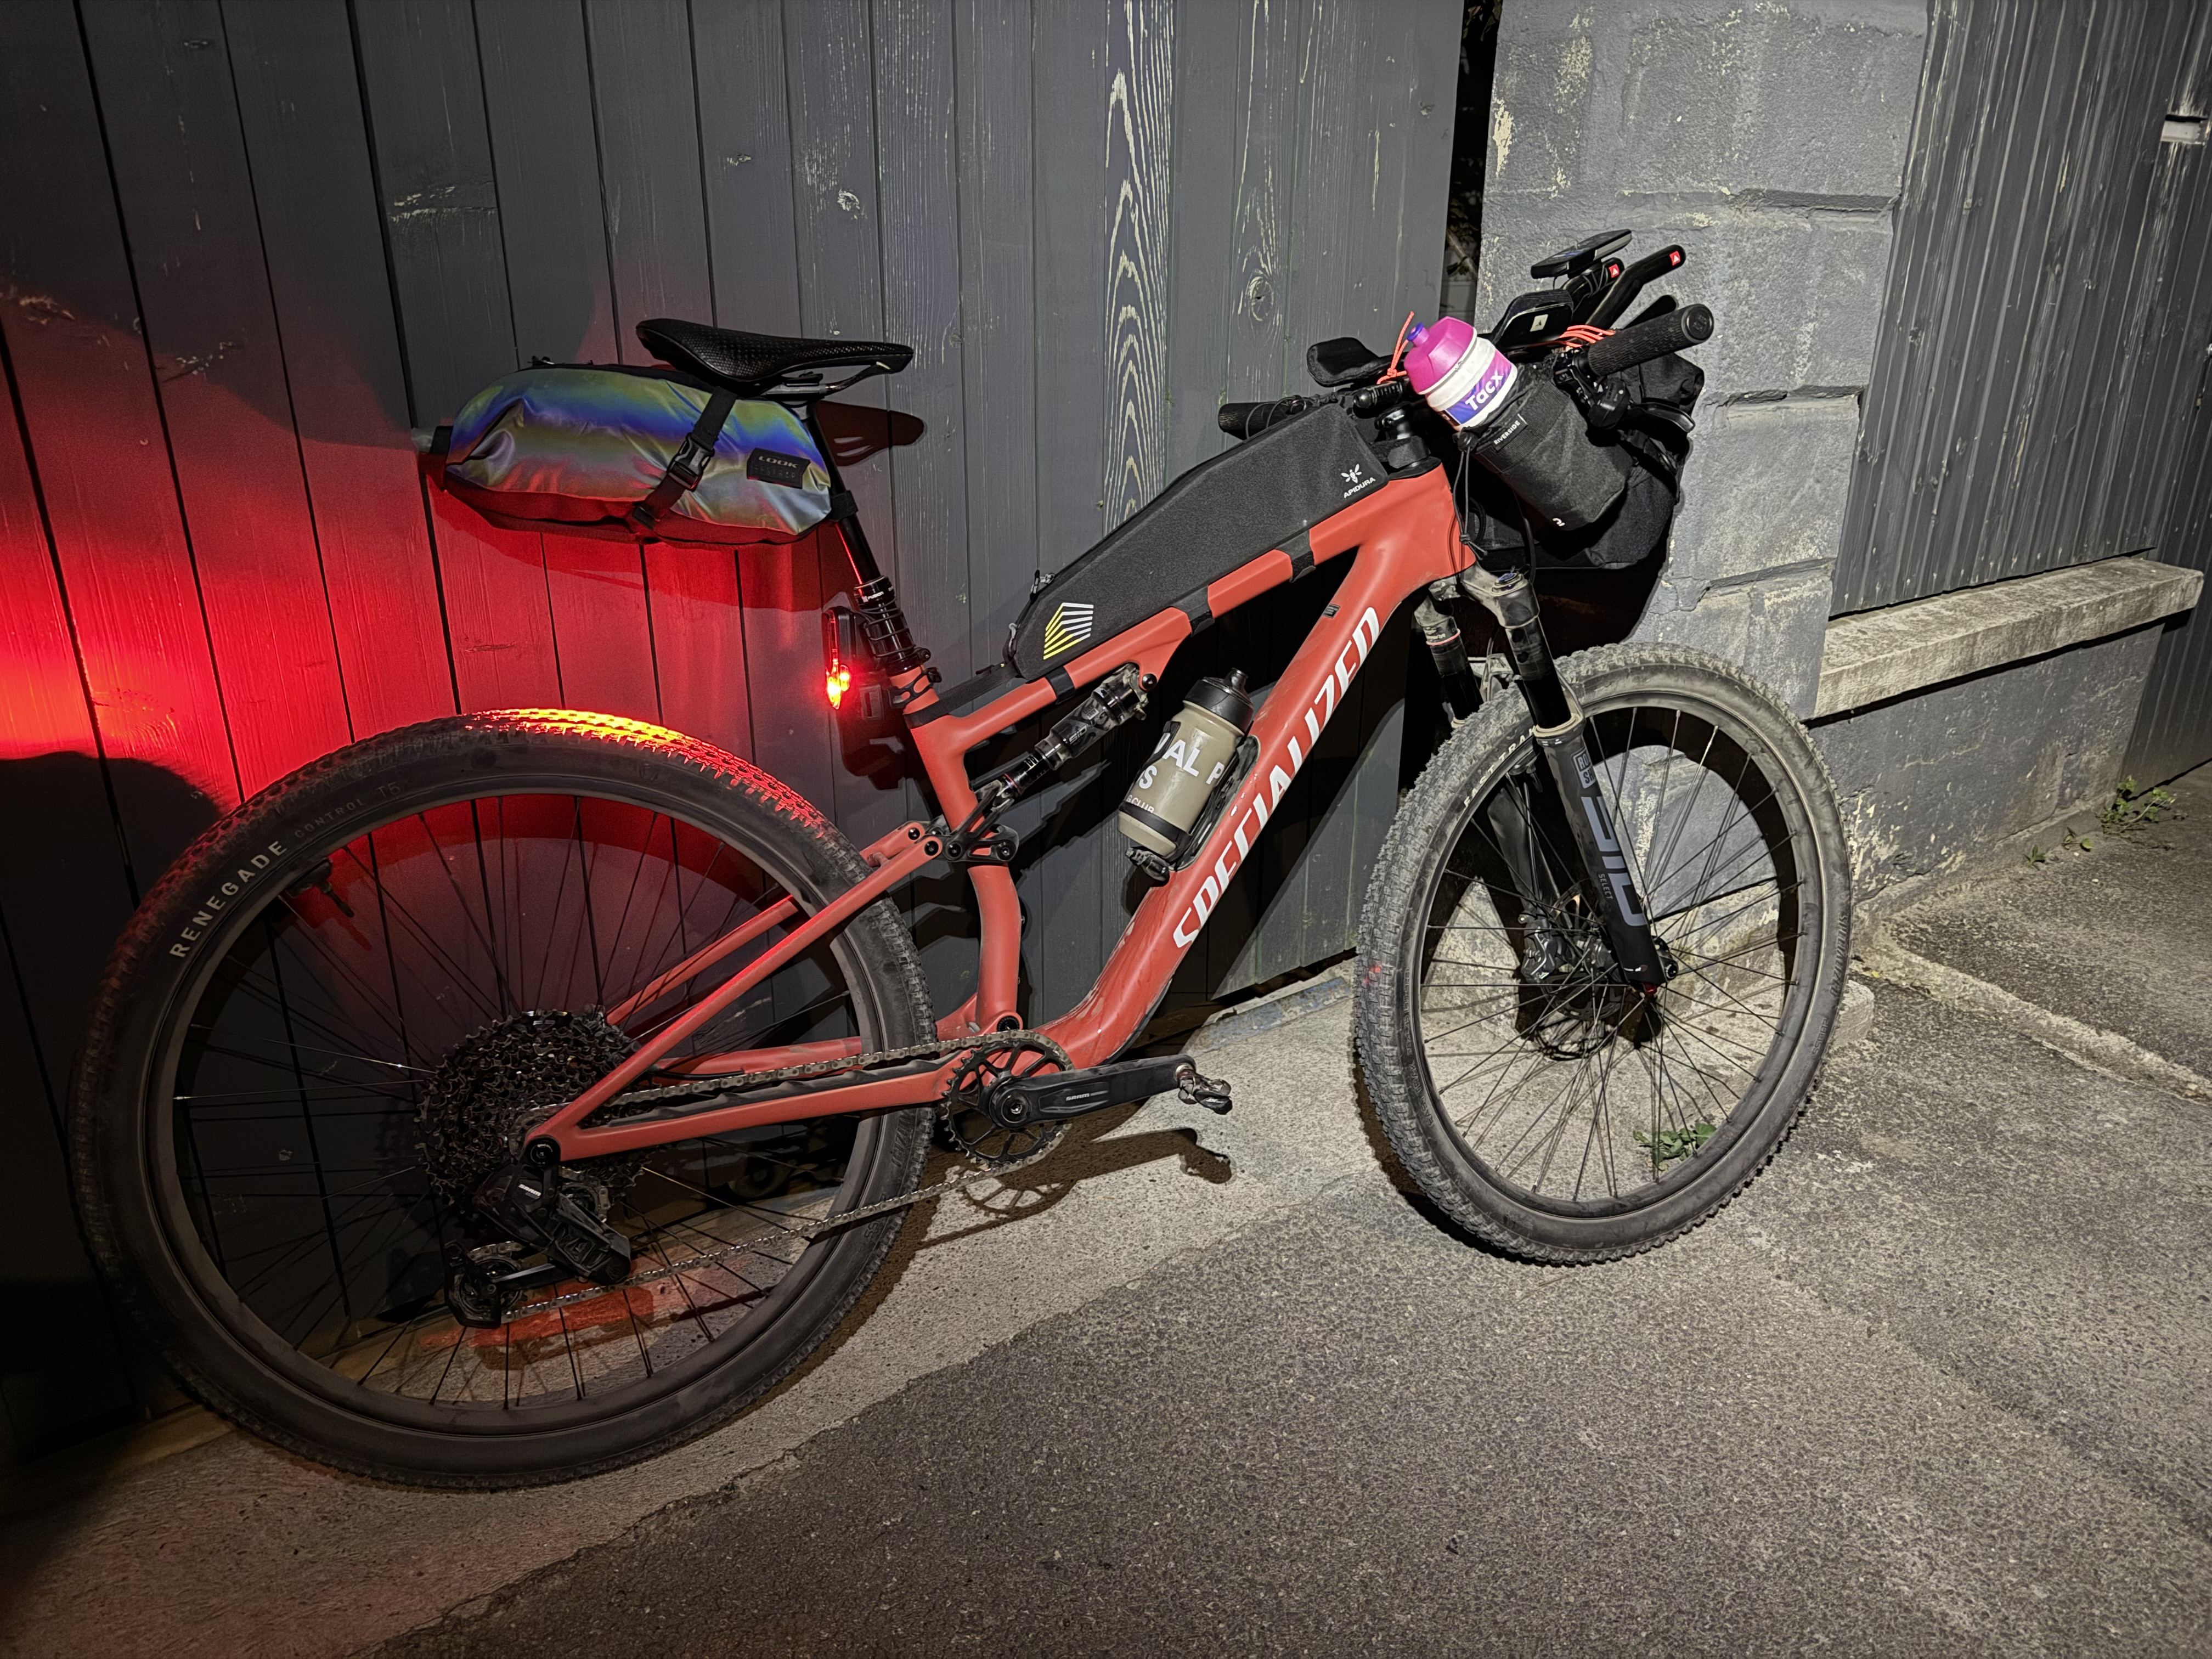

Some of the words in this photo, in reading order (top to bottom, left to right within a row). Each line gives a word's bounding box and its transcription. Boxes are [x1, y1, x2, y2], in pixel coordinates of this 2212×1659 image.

[1465, 369, 1504, 411] Tacx
[1493, 420, 1521, 445] RIVERSIDE
[758, 456, 798, 469] LOOK
[1344, 477, 1376, 499] APIDURA
[1172, 607, 1380, 949] SPECIALIZED
[1206, 761, 1225, 785] P
[170, 840, 287, 958] RENEGADE
[375, 782, 400, 798] T5
[1598, 872, 1613, 900] SELECT
[1065, 1093, 1090, 1101] SRAM
[518, 1184, 541, 1196] SRAM
